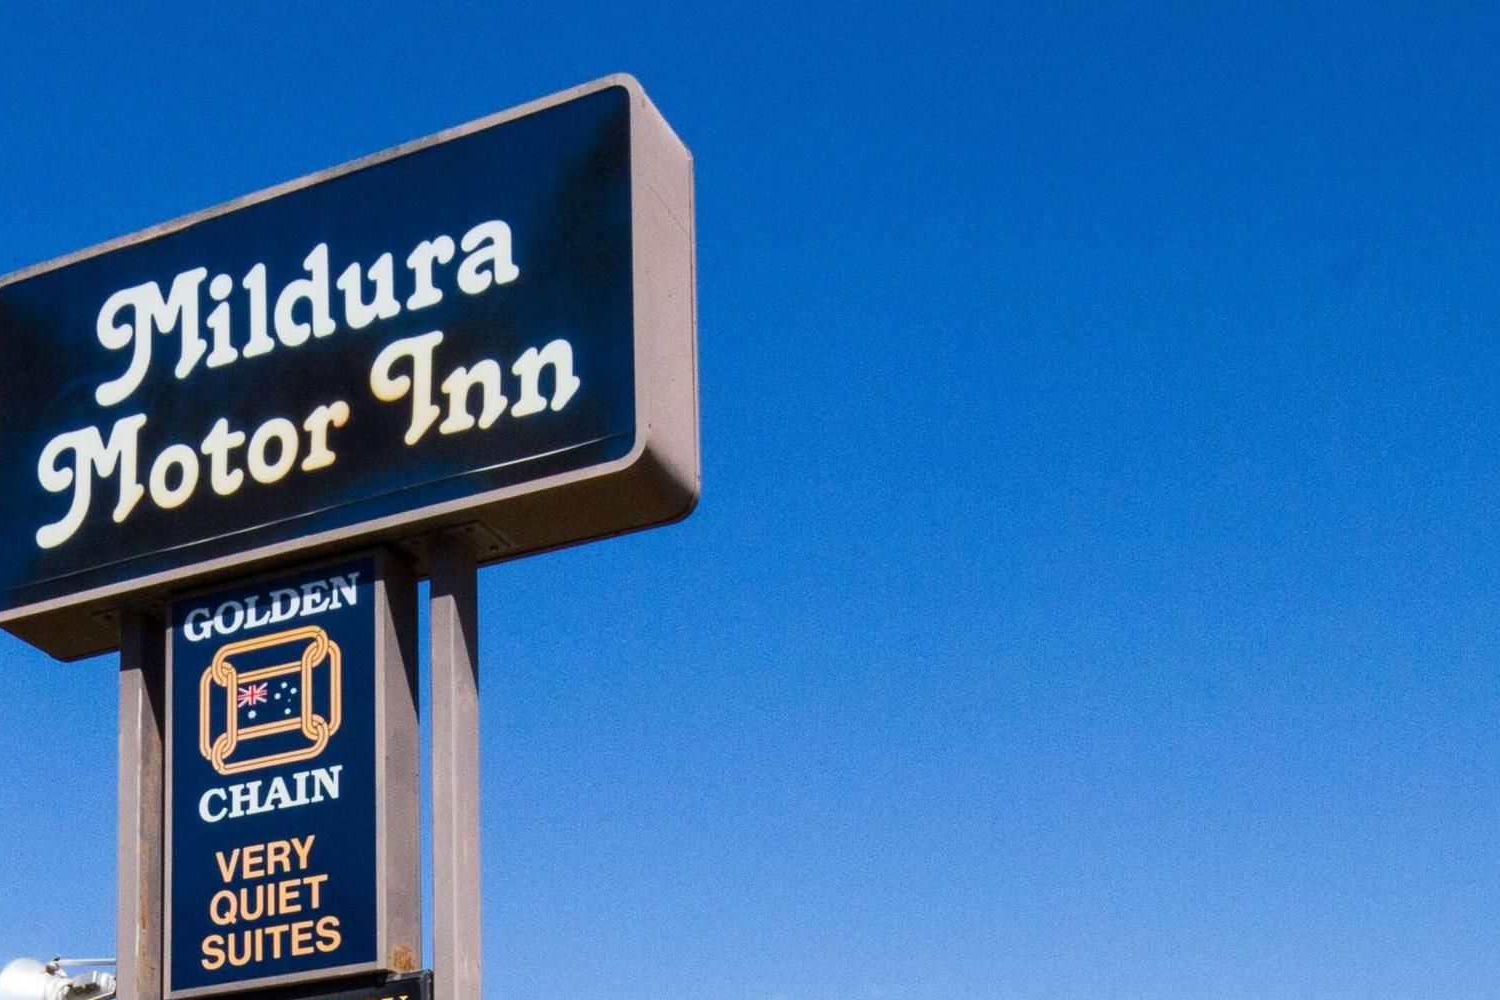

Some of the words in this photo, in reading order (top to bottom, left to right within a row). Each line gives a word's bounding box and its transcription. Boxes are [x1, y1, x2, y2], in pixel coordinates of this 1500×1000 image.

[95, 219, 520, 407] Mildura
[35, 401, 350, 549] Motor
[369, 330, 581, 446] Inn
[183, 572, 360, 642] GOLDEN
[199, 765, 343, 823] CHAIN
[215, 834, 316, 883] VERY
[209, 873, 329, 926] QUIET
[201, 915, 342, 971] SUITES
